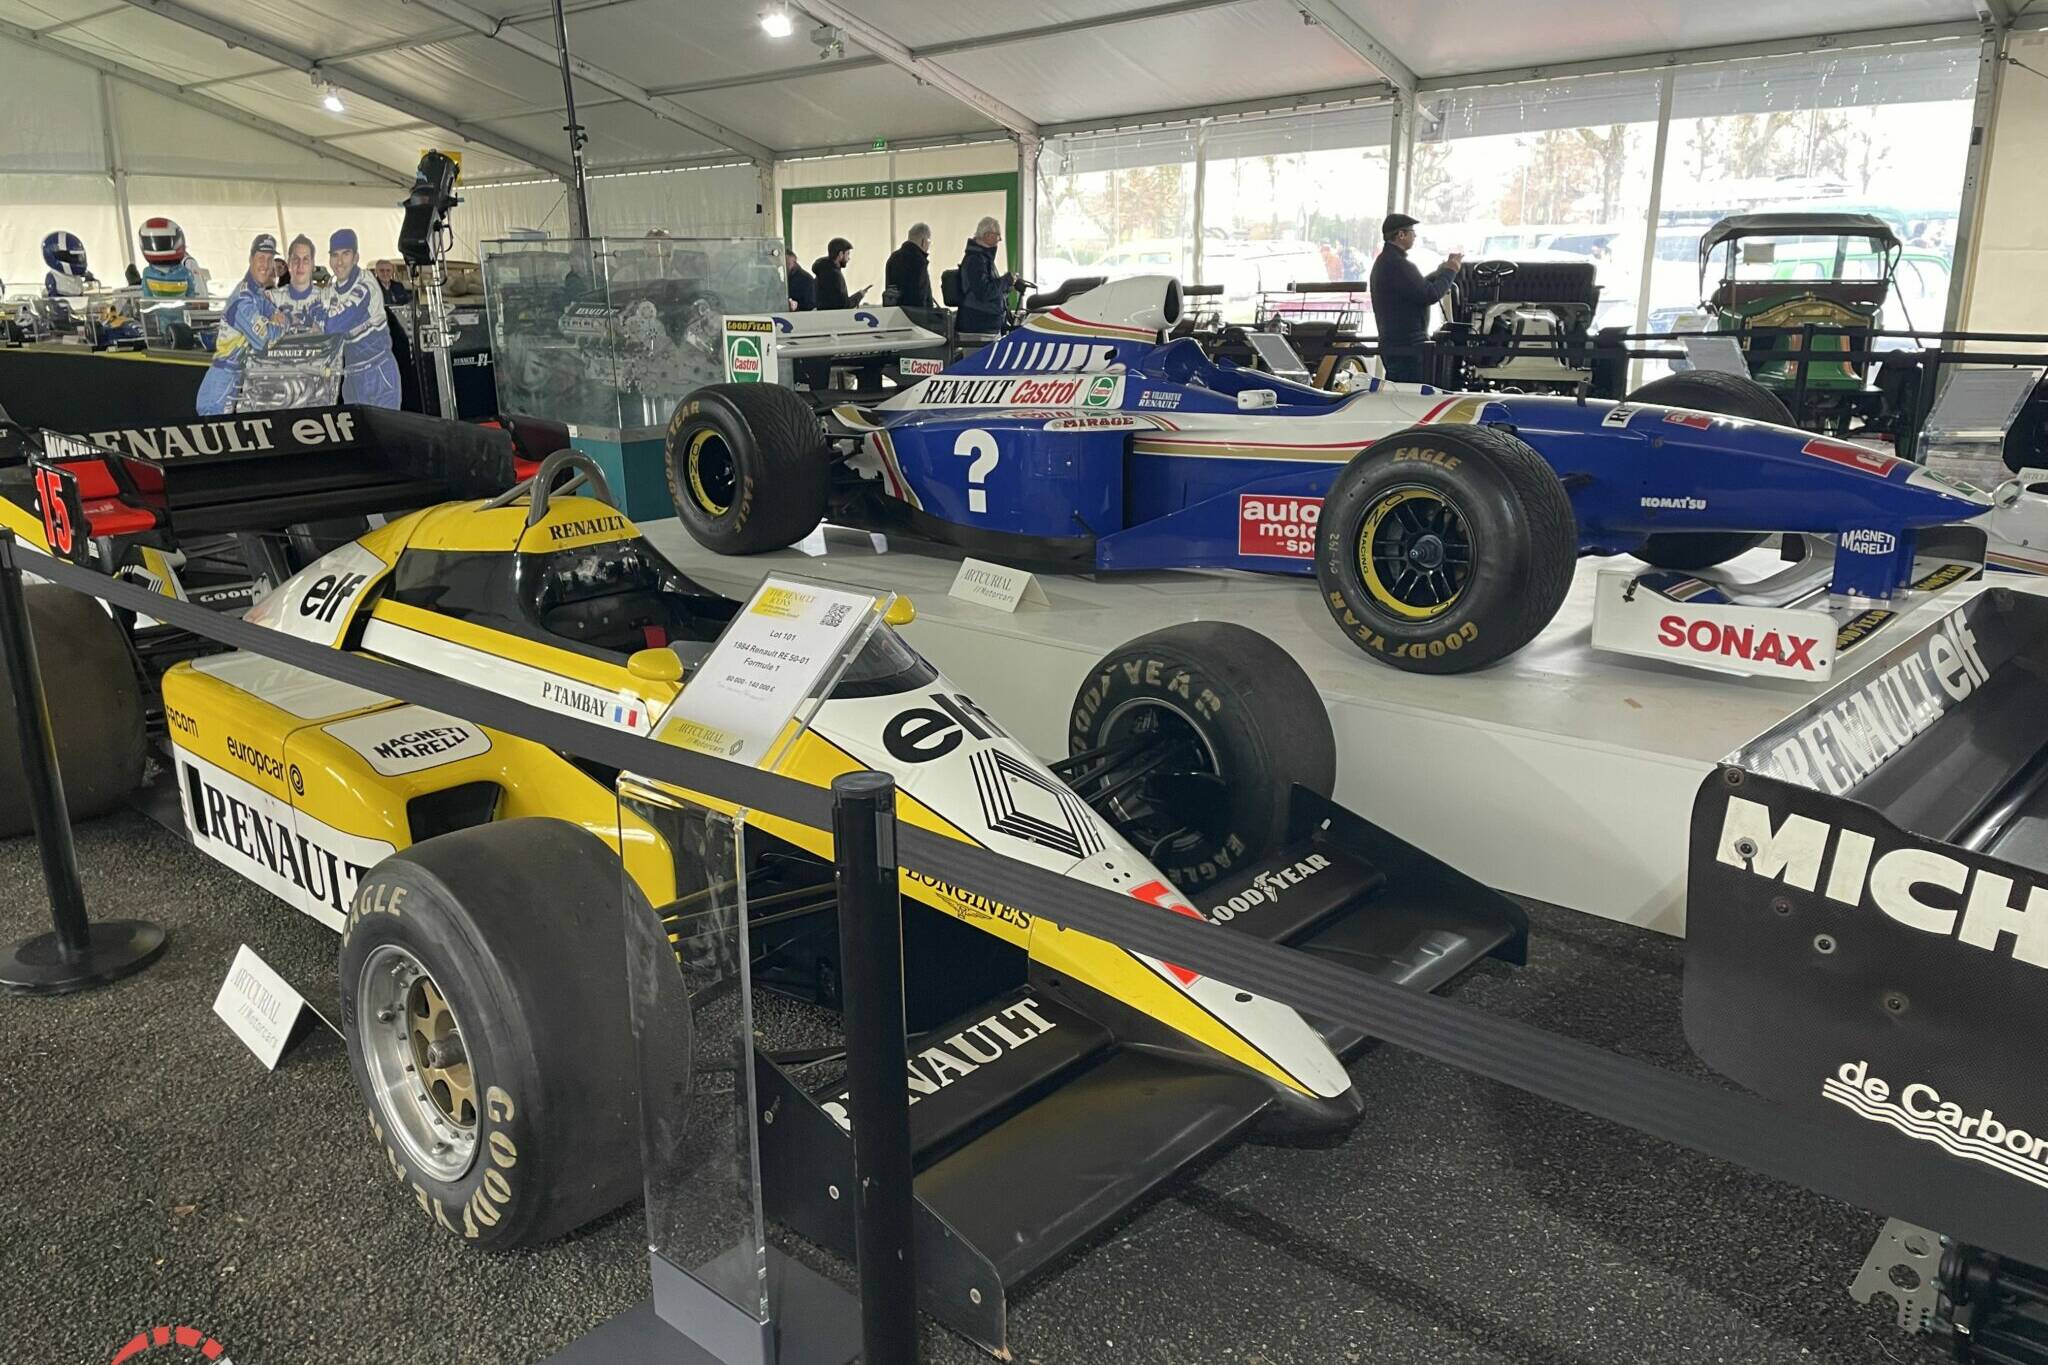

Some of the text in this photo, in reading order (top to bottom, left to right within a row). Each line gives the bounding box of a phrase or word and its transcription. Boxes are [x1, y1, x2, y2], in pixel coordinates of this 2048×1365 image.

[826, 179, 965, 199] SORTIE DE SECOURS
[267, 349, 303, 358] RENAULT
[734, 356, 759, 371] Castrol
[911, 360, 943, 375] Castrol
[919, 378, 1083, 405] RENAULT Castrol
[1138, 398, 1180, 409] RENAULT
[292, 413, 354, 445] elf
[1063, 416, 1135, 429] MIRAGE
[1392, 447, 1463, 471] EAGLE
[35, 466, 73, 554] 15
[1243, 500, 1320, 523] auto
[1641, 497, 1706, 510] KOMATSU
[548, 515, 626, 541] RENAULT
[962, 568, 1012, 592] ARTCURIAL
[299, 574, 369, 623] elf
[769, 628, 797, 641] Lot 101
[1657, 615, 1825, 672] SONAX
[734, 641, 750, 651] 1984
[749, 644, 778, 658] Renault
[777, 651, 789, 660] RE
[744, 657, 774, 671] Formule
[1772, 607, 1990, 796] RENAULT elf
[226, 736, 285, 782] europcar
[231, 967, 281, 1024] ARTCURIAL
[1839, 1061, 1889, 1102] de
